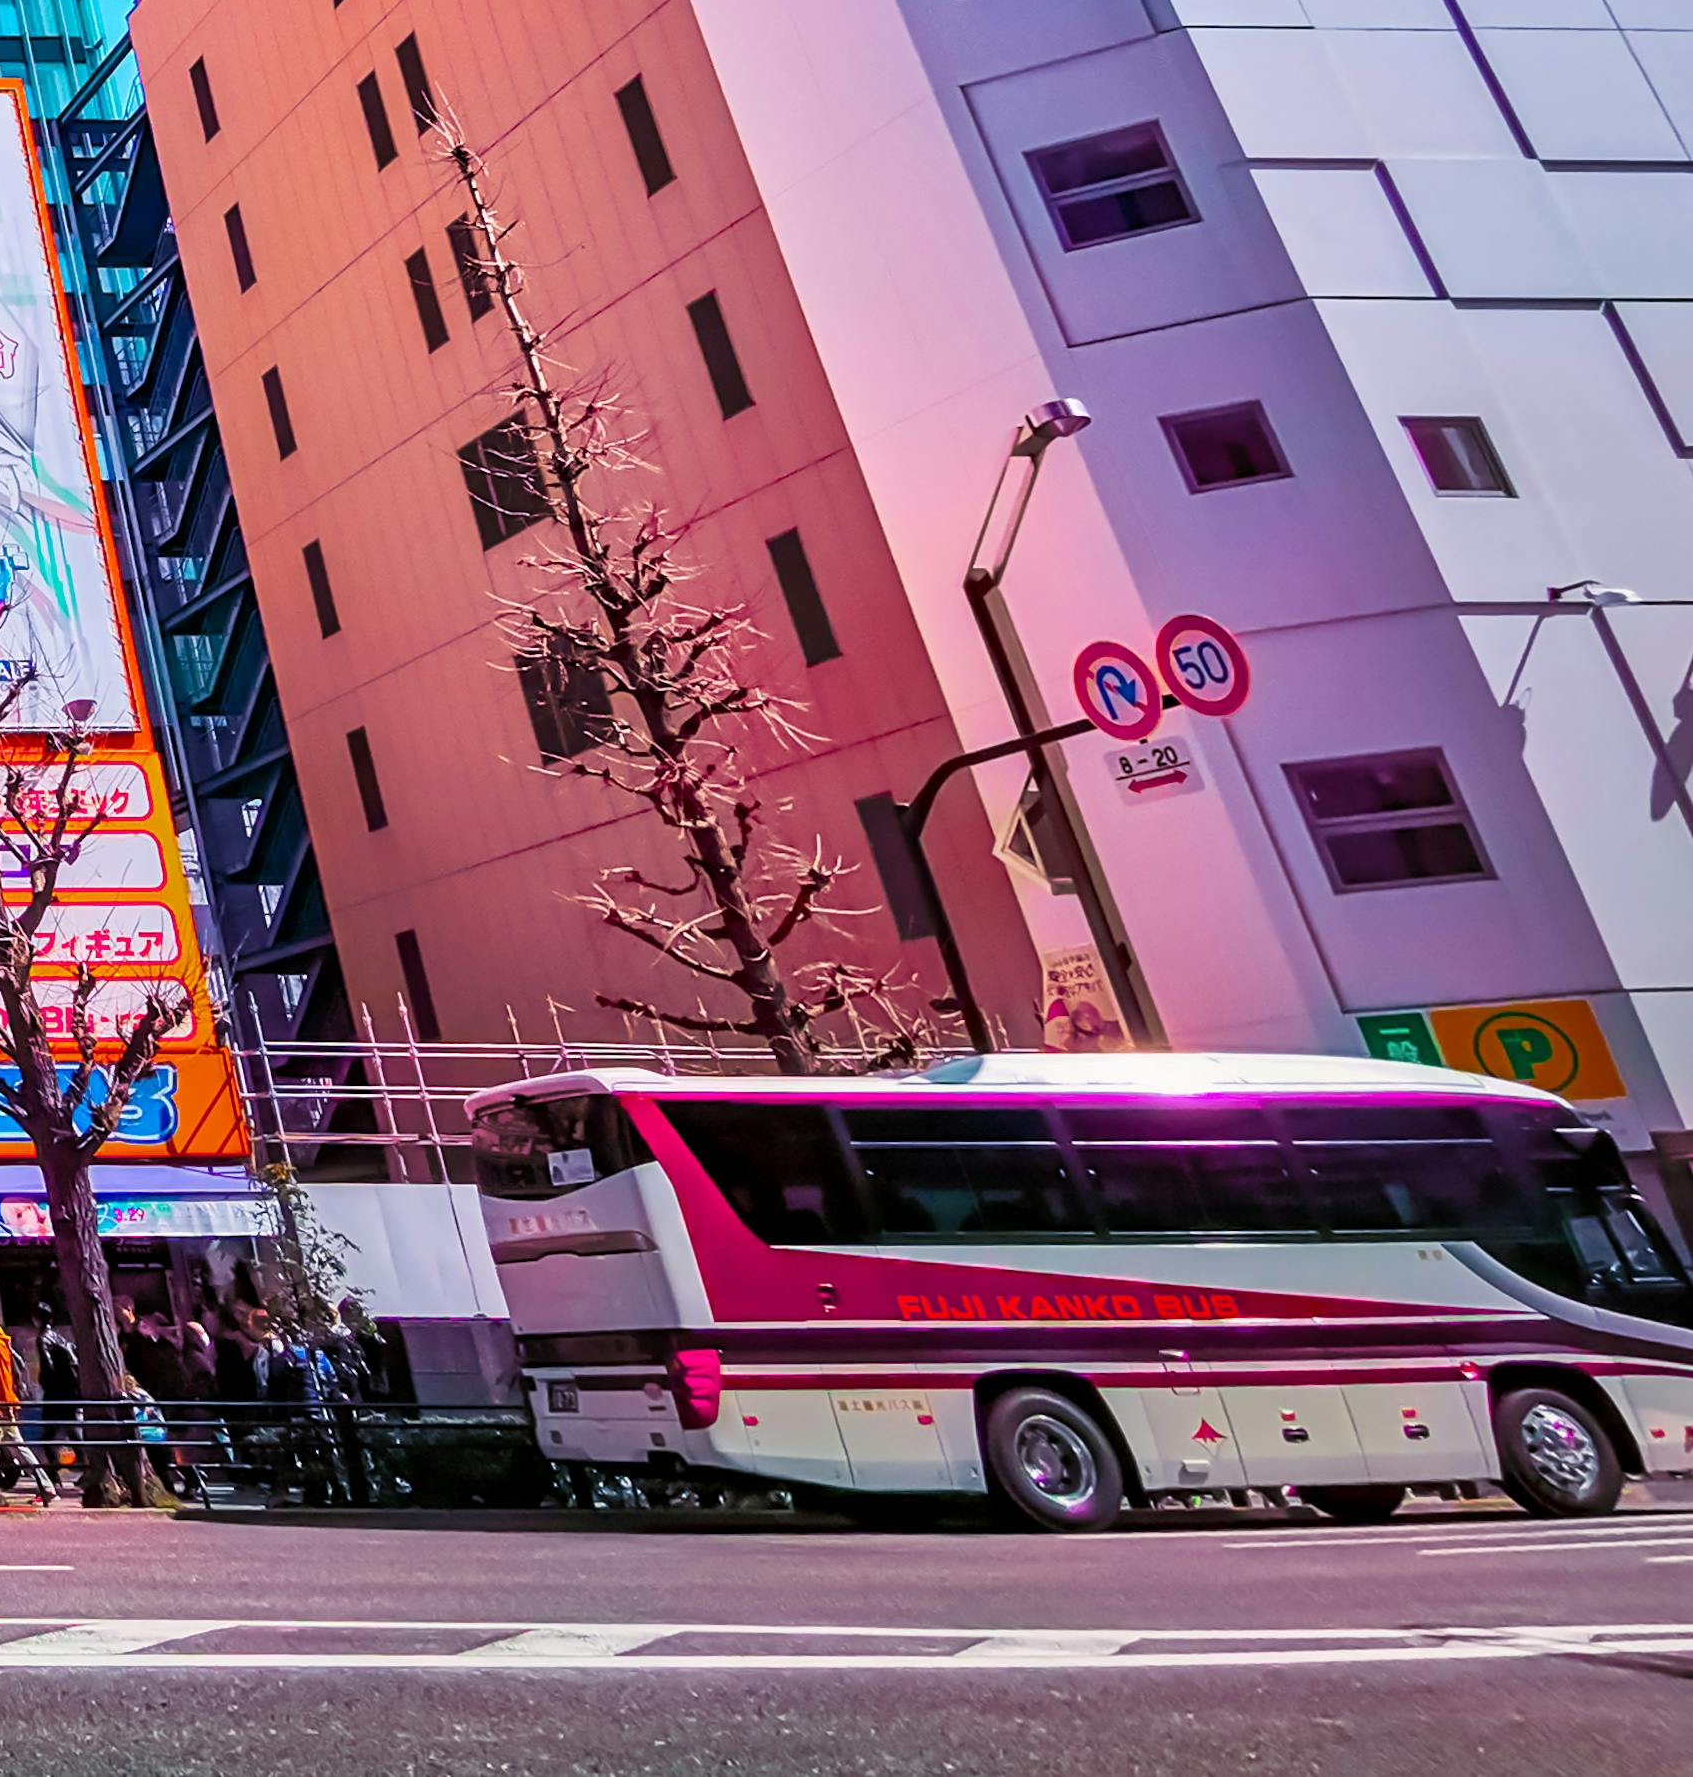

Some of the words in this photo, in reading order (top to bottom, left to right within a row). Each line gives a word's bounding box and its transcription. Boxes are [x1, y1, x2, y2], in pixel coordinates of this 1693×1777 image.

[1173, 640, 1230, 691] 50
[1494, 1027, 1554, 1081] P
[897, 1294, 986, 1321] FUJI
[998, 1294, 1143, 1320] KANKO
[1154, 1294, 1240, 1318] BUS
